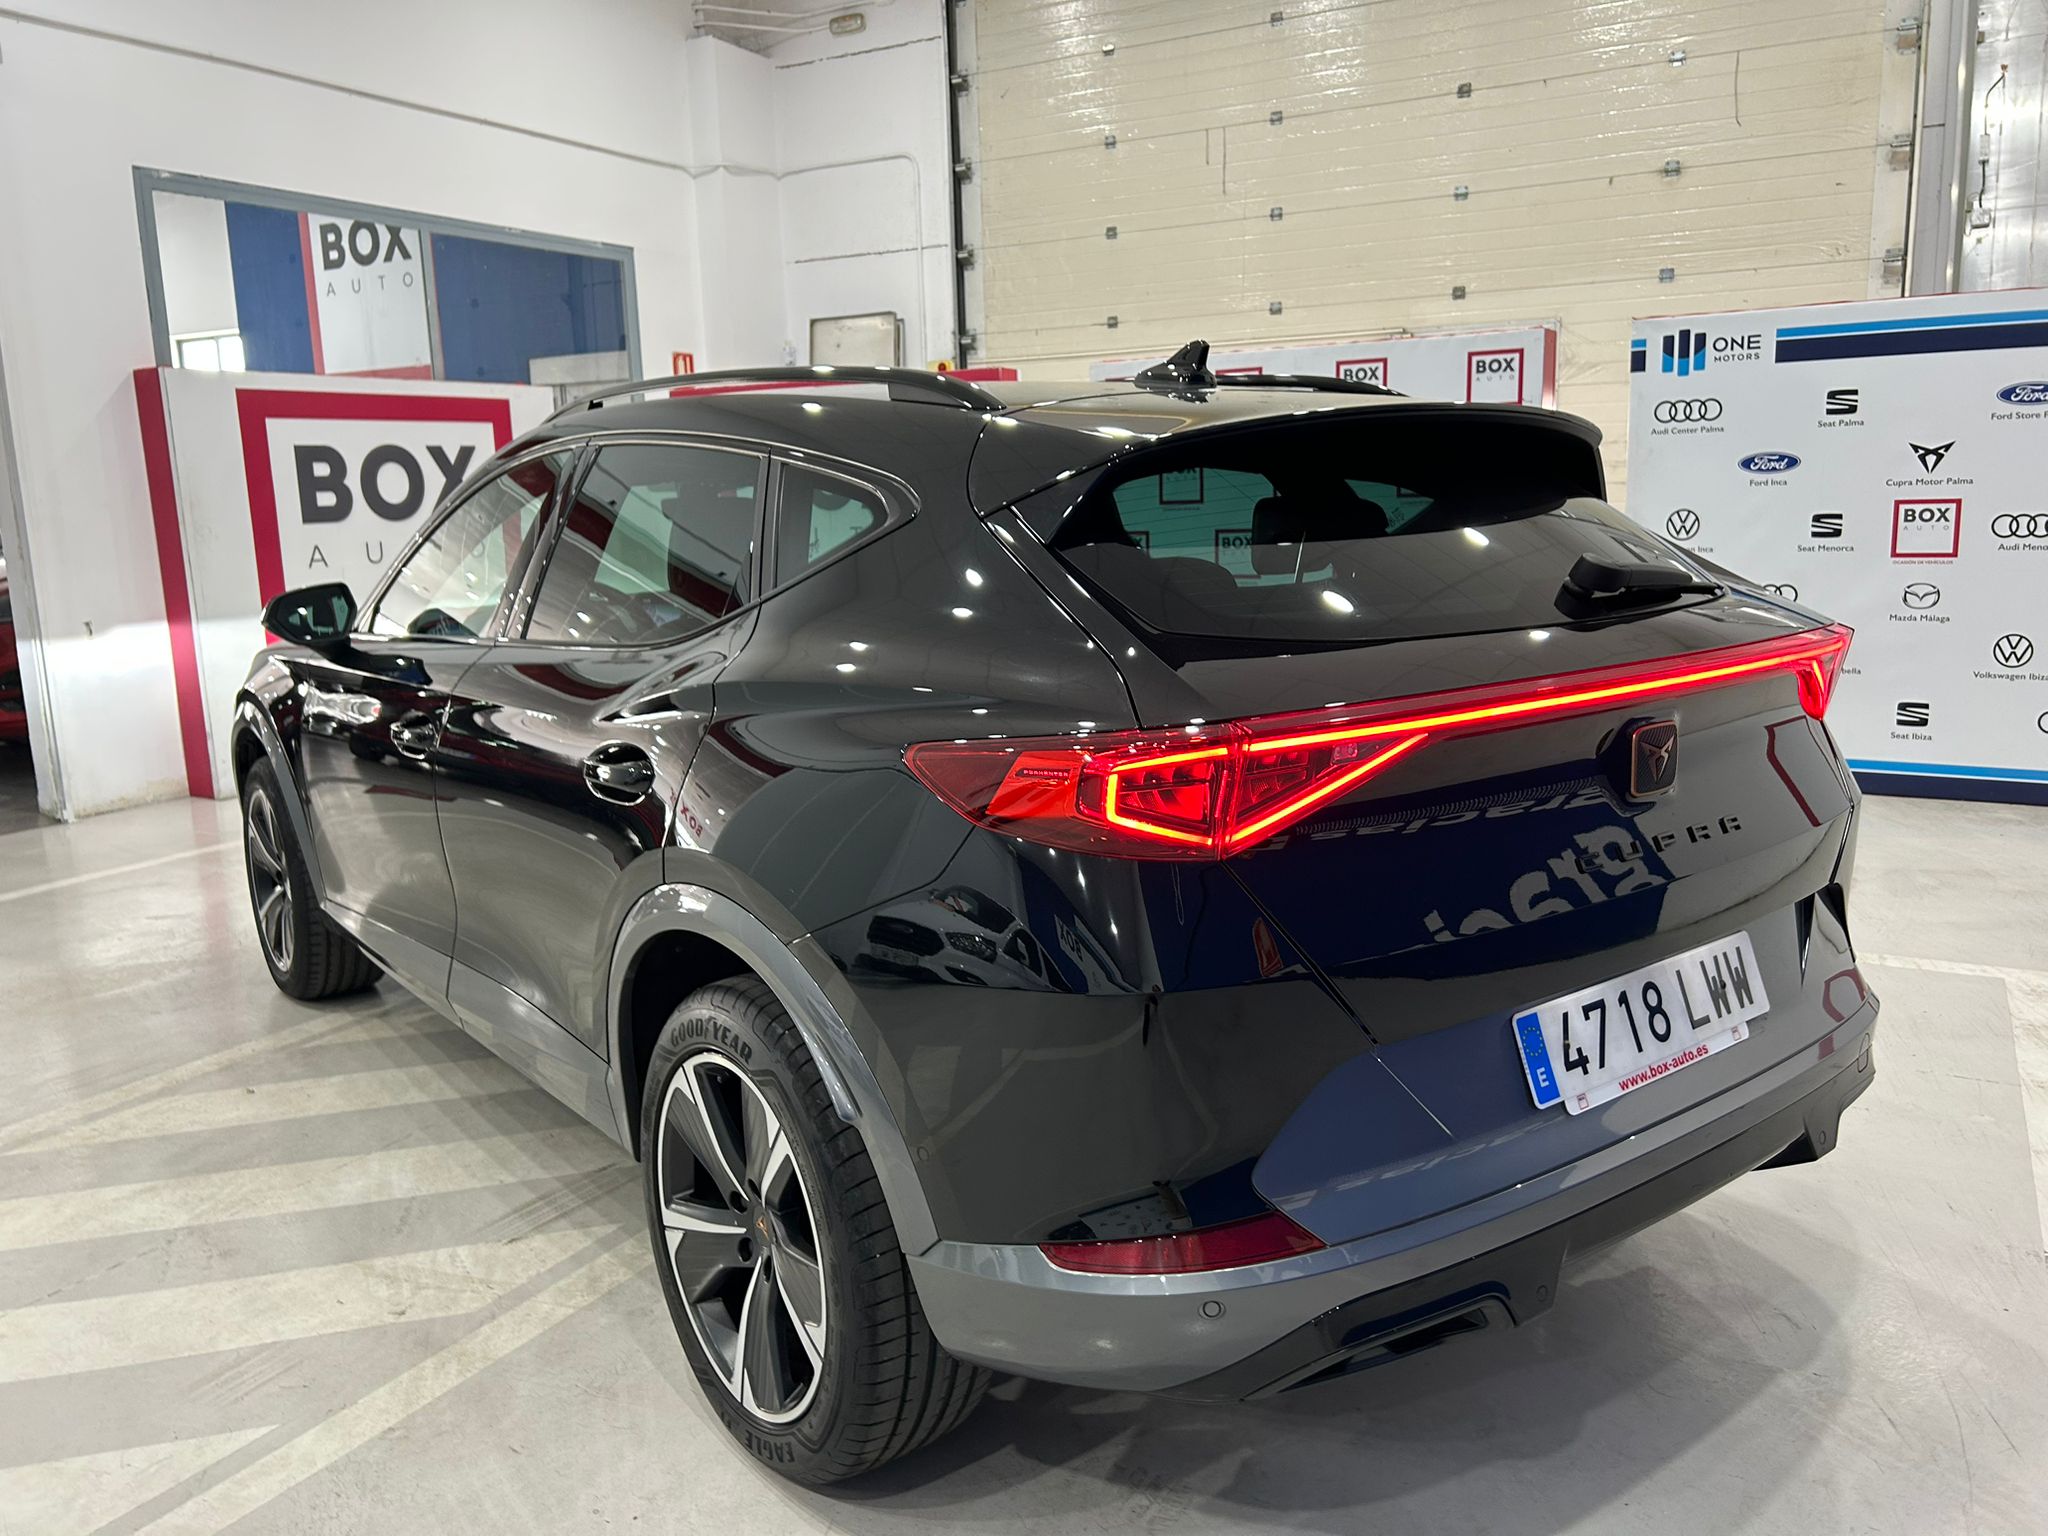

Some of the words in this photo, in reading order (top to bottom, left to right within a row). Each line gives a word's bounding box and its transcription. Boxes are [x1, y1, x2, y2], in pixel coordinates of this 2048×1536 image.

[318, 219, 413, 272] BOX
[326, 271, 414, 297] AUTO
[1712, 334, 1762, 353] ONE
[1476, 357, 1515, 374] BOX
[1713, 352, 1761, 363] MOTORS
[1343, 366, 1380, 383] BOX
[1817, 420, 1836, 428] Seat
[1838, 418, 1865, 427] Palma
[1991, 411, 2013, 421] Ford
[2015, 411, 2041, 420] Store
[1651, 427, 1669, 436] Audi
[1671, 427, 1698, 435] Center
[1700, 425, 1725, 434] Palma
[1750, 455, 1788, 471] Ford
[294, 444, 476, 524] BOX
[1749, 479, 1769, 487] Ford
[1770, 479, 1788, 487] Inca
[1885, 479, 1913, 488] Cupra
[1915, 478, 1944, 486] Motor
[1946, 477, 1974, 485] Palma
[1903, 507, 1951, 523] BOX
[1797, 545, 1815, 553] Seat
[1817, 545, 1854, 553] Menorca
[1997, 543, 2020, 551] Audi
[1889, 614, 1917, 622] Mazda
[1919, 614, 1950, 624] Málaga
[1973, 671, 2026, 681] Volkswagen
[1890, 732, 1909, 740] Seat
[1911, 732, 1932, 741] Ibiza
[1561, 980, 1672, 1076] 4718
[1675, 946, 1755, 1030] LWW
[1618, 1044, 1709, 1091] www.box-auto.es
[1535, 1066, 1550, 1088] E
[744, 1429, 796, 1464] EAGLE
